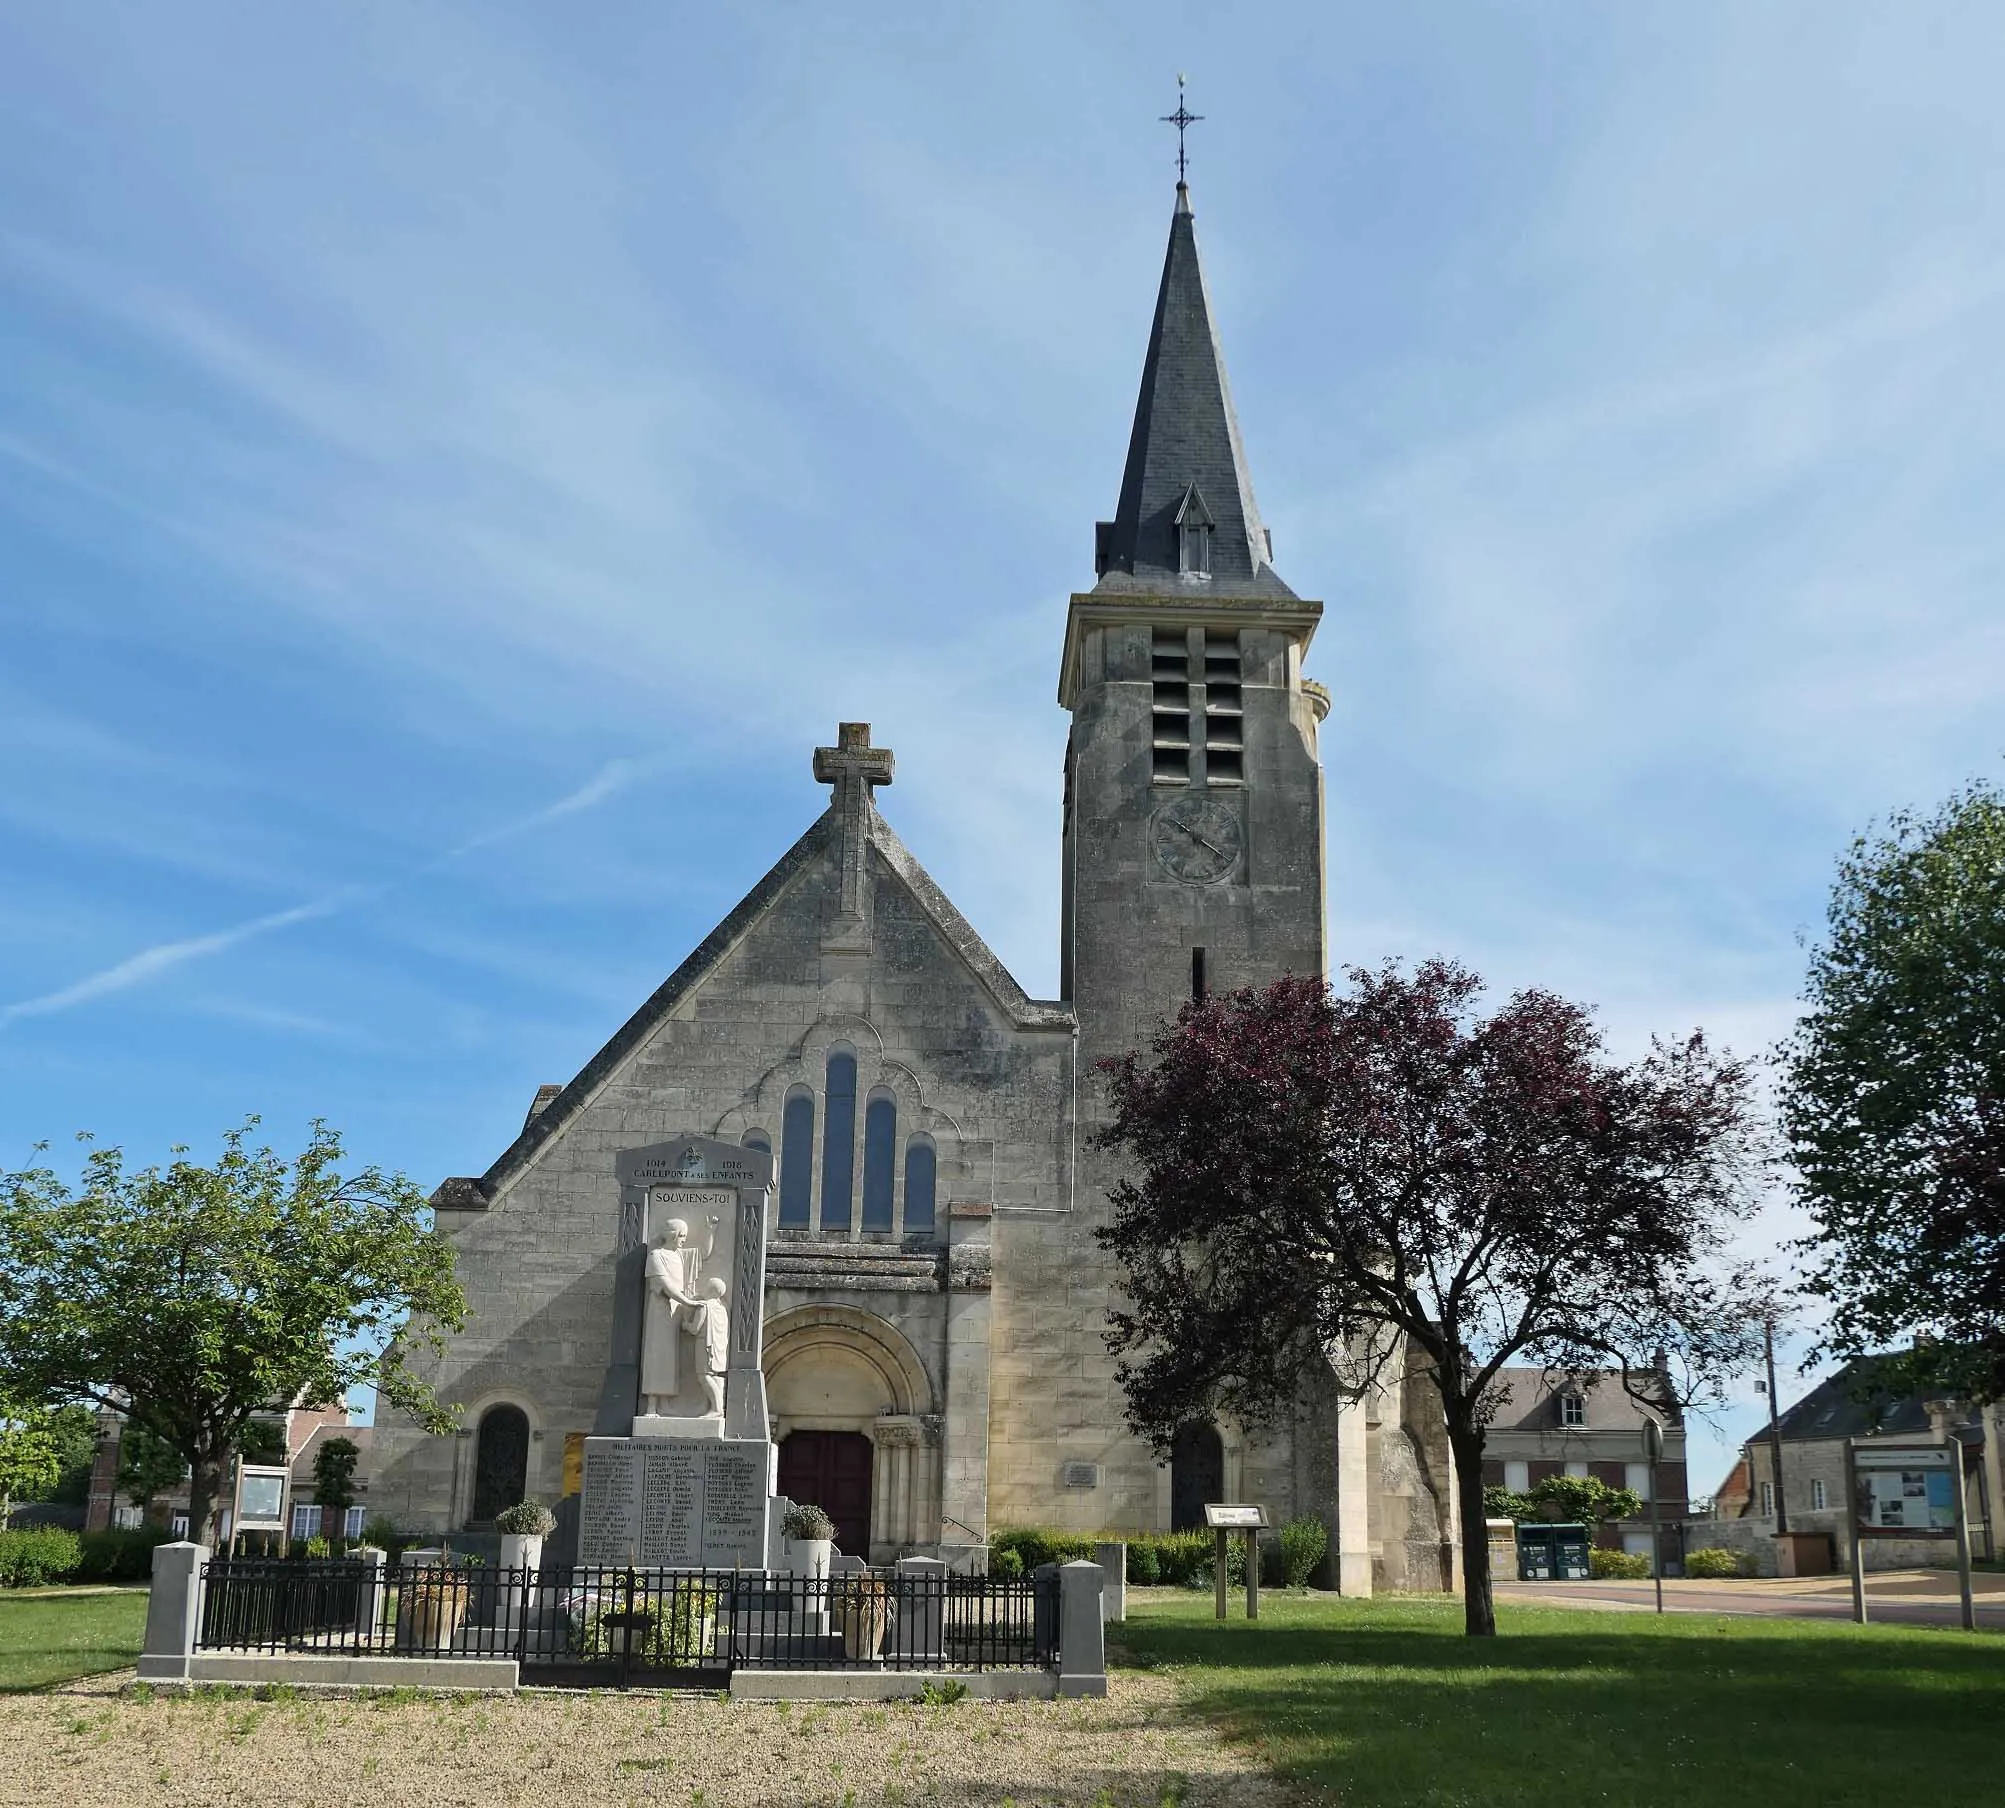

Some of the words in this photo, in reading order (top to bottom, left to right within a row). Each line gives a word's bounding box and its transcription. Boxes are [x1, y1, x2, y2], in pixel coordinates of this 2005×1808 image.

[722, 1160, 742, 1169] 1918
[712, 1171, 754, 1180] ENFANTS
[655, 1192, 730, 1204] SOUVIENS-TOI
